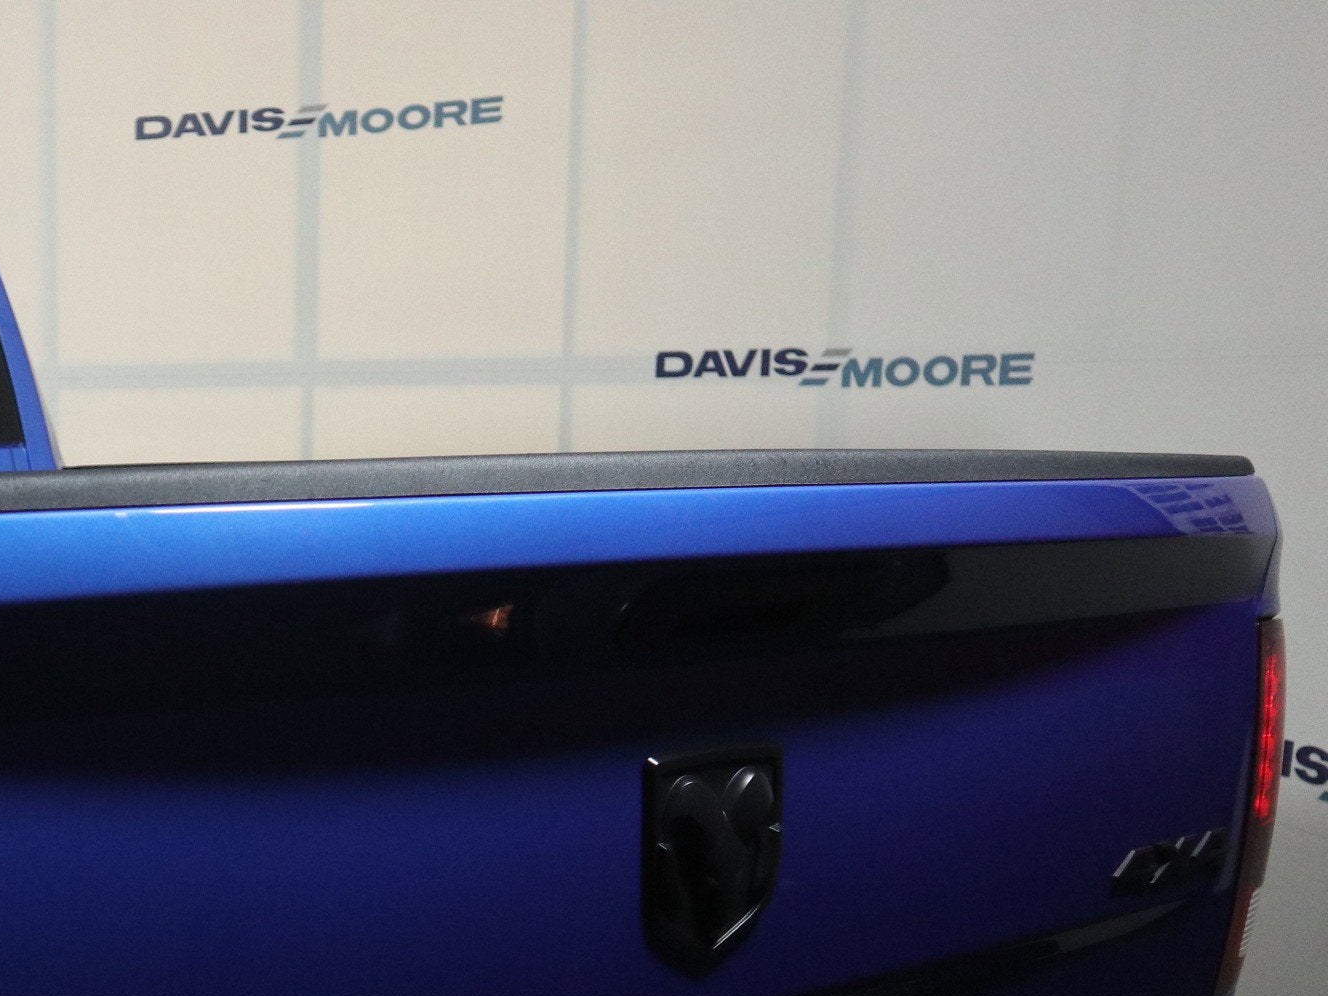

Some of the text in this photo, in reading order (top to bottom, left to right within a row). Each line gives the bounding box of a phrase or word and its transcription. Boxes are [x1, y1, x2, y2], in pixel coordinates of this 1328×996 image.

[135, 96, 504, 140] DAVIS MOORE
[655, 347, 1036, 388] DAVIS MOORE
